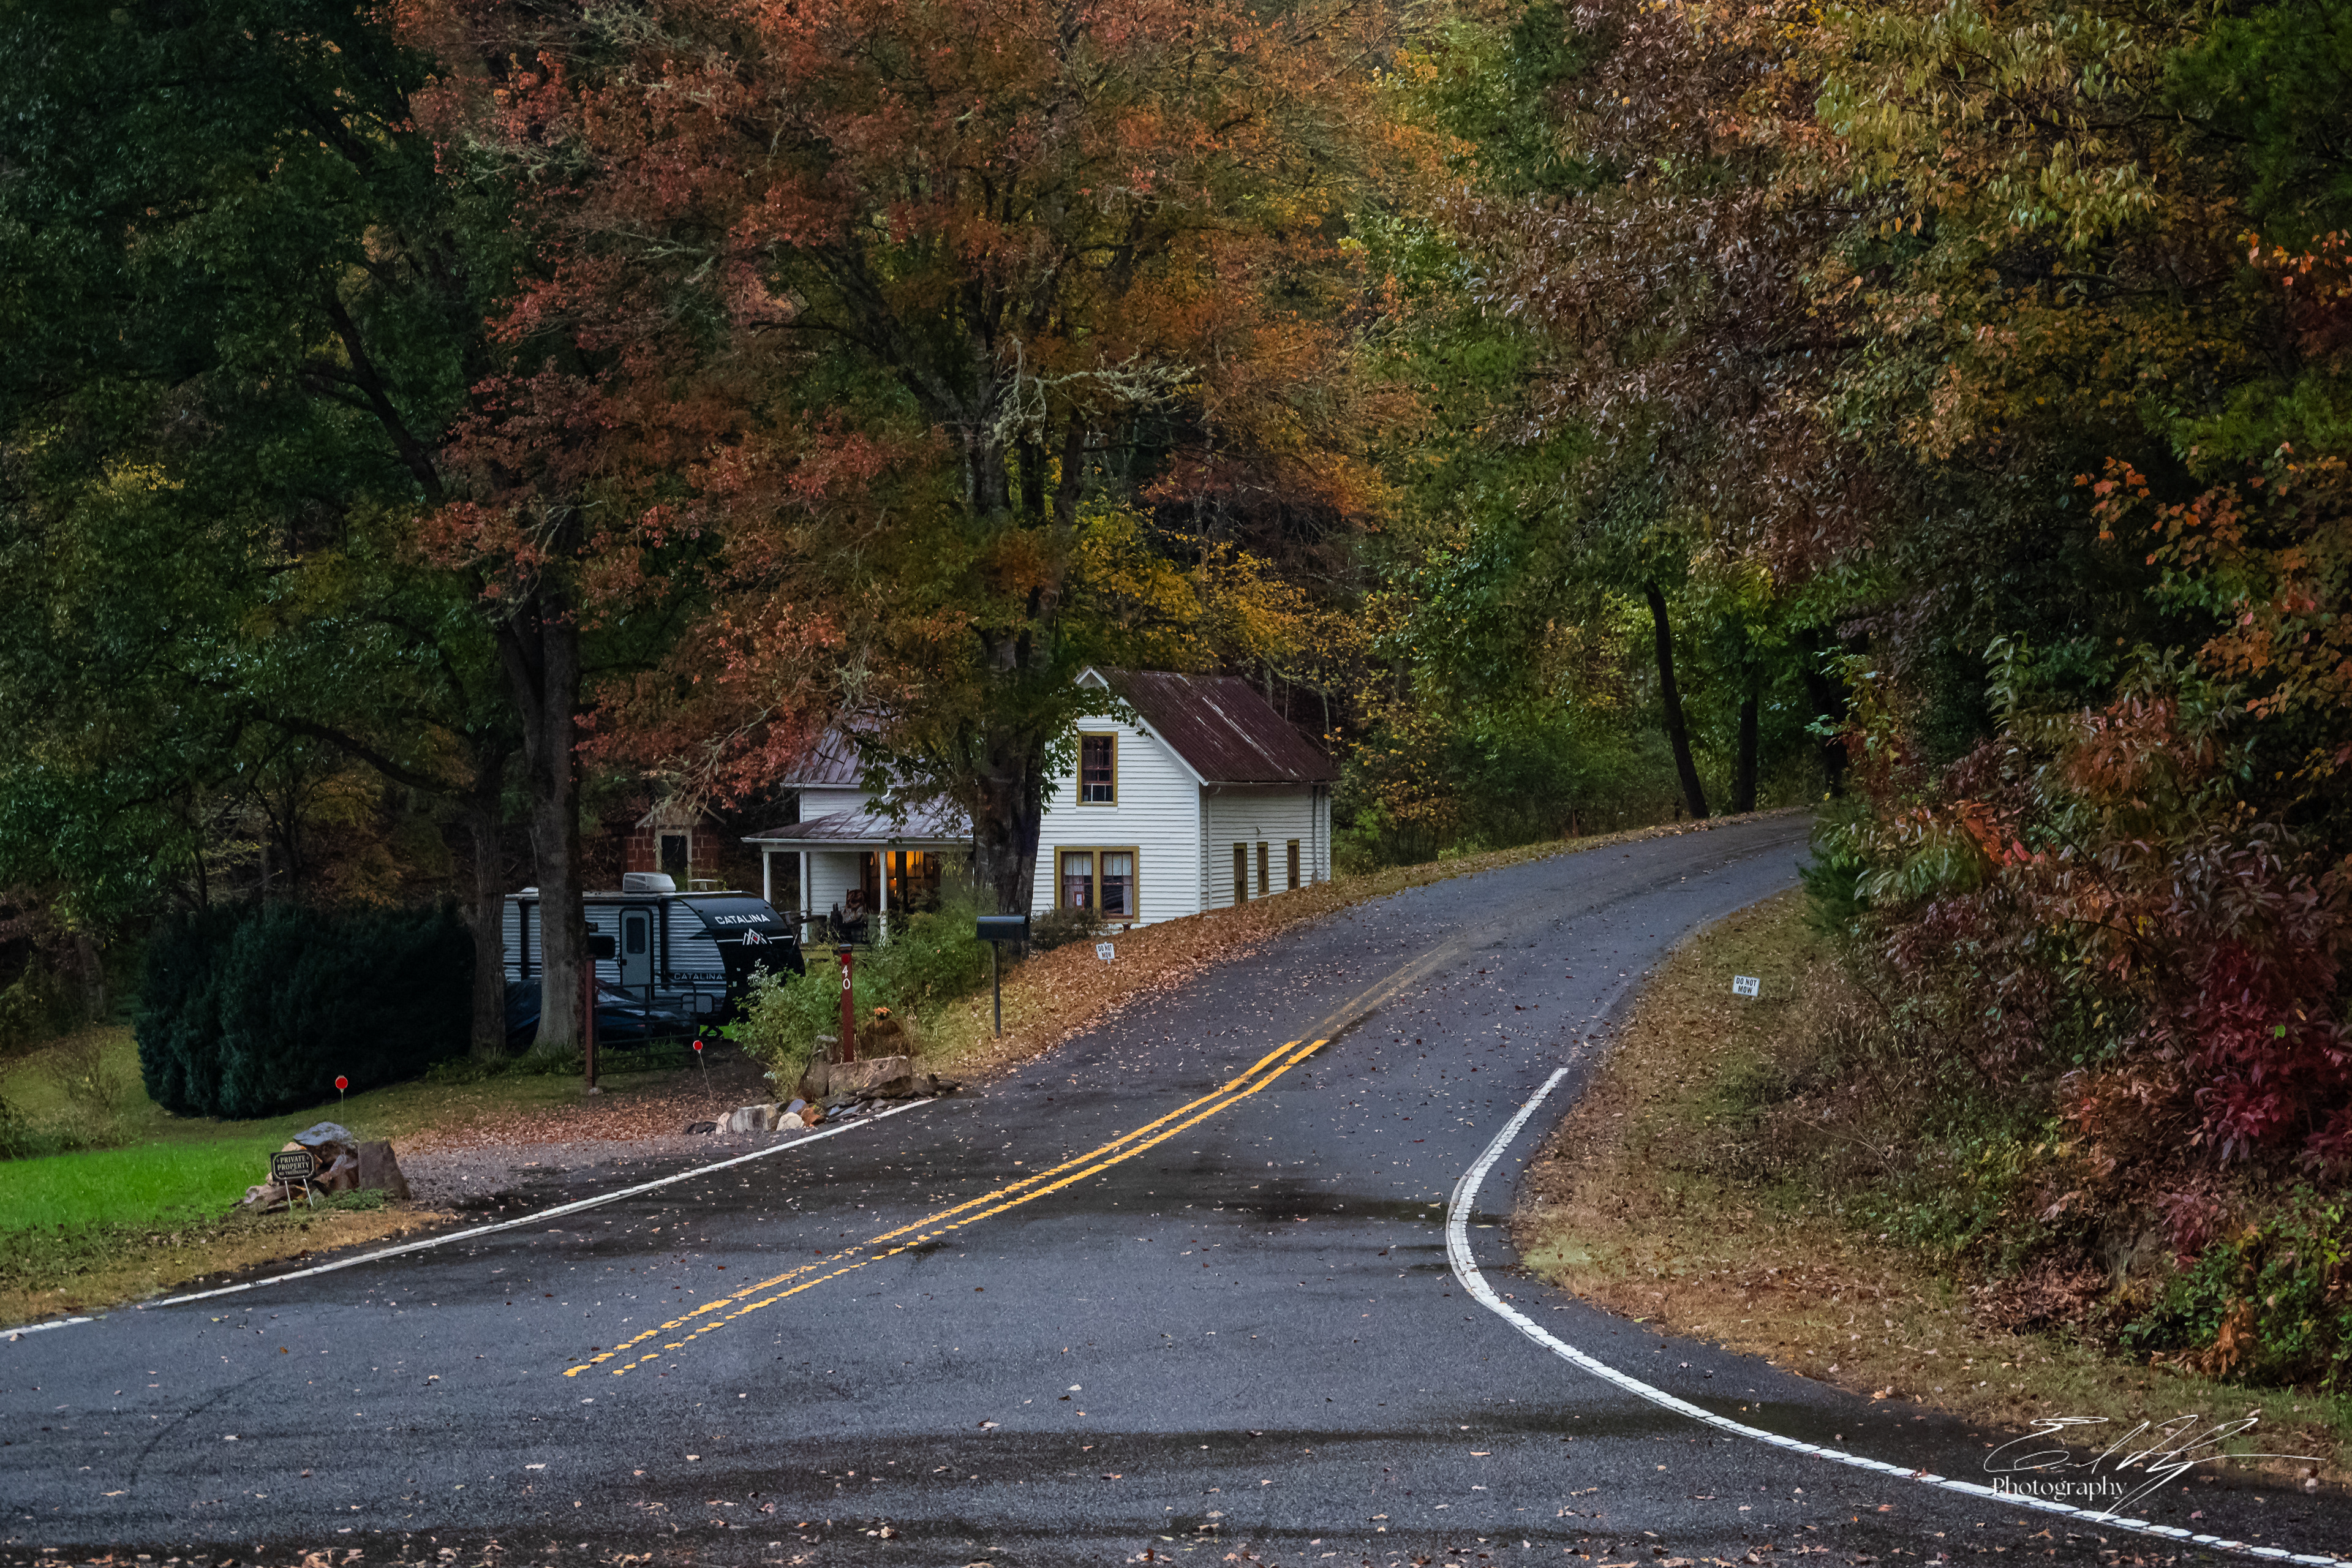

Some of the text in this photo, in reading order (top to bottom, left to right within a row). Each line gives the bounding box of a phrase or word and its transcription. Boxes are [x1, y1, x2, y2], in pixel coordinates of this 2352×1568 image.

[714, 913, 771, 925] CATALINA
[1745, 978, 1757, 987] NOT
[1738, 985, 1753, 994] MOW
[280, 1155, 306, 1164] PRIVATE
[277, 1161, 309, 1170] PROPERTY
